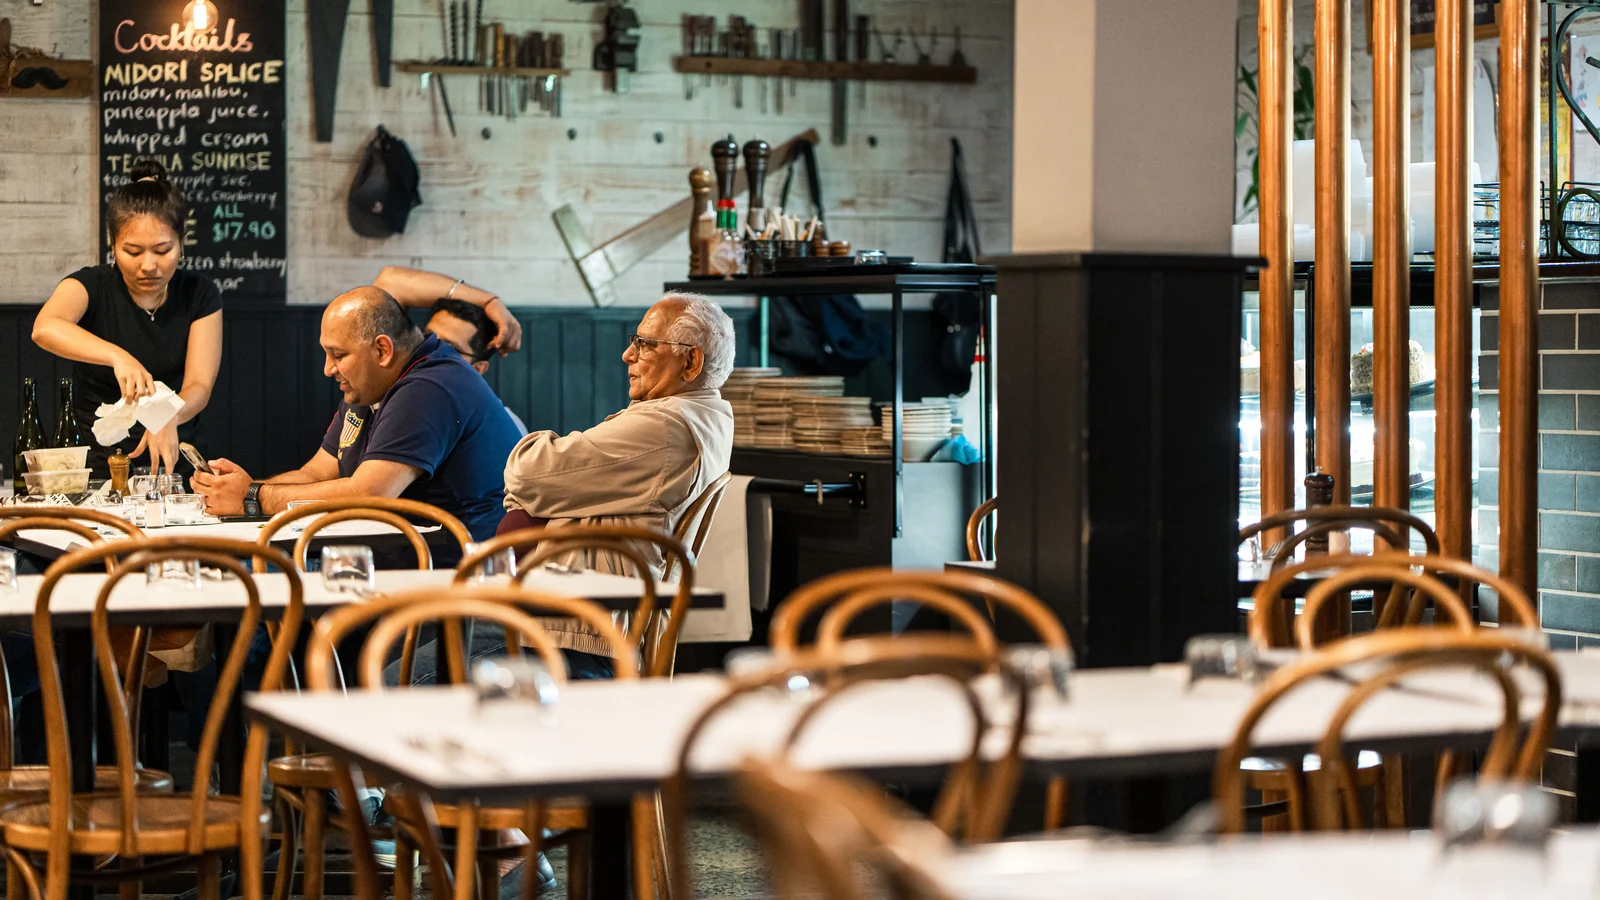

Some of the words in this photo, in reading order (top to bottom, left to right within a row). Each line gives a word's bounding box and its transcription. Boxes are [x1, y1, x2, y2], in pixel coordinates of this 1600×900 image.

[114, 17, 254, 54] Cocktails
[104, 59, 188, 87] MIDORI
[200, 60, 284, 84] SPLICE
[103, 85, 172, 102] midori,
[175, 86, 248, 101] malibu,
[207, 104, 269, 124] juice,
[104, 125, 187, 153] whipped
[191, 151, 272, 171] SUNRISE
[213, 203, 244, 218] ALL
[212, 220, 276, 243] $17.90
[218, 250, 288, 278] strawberry
